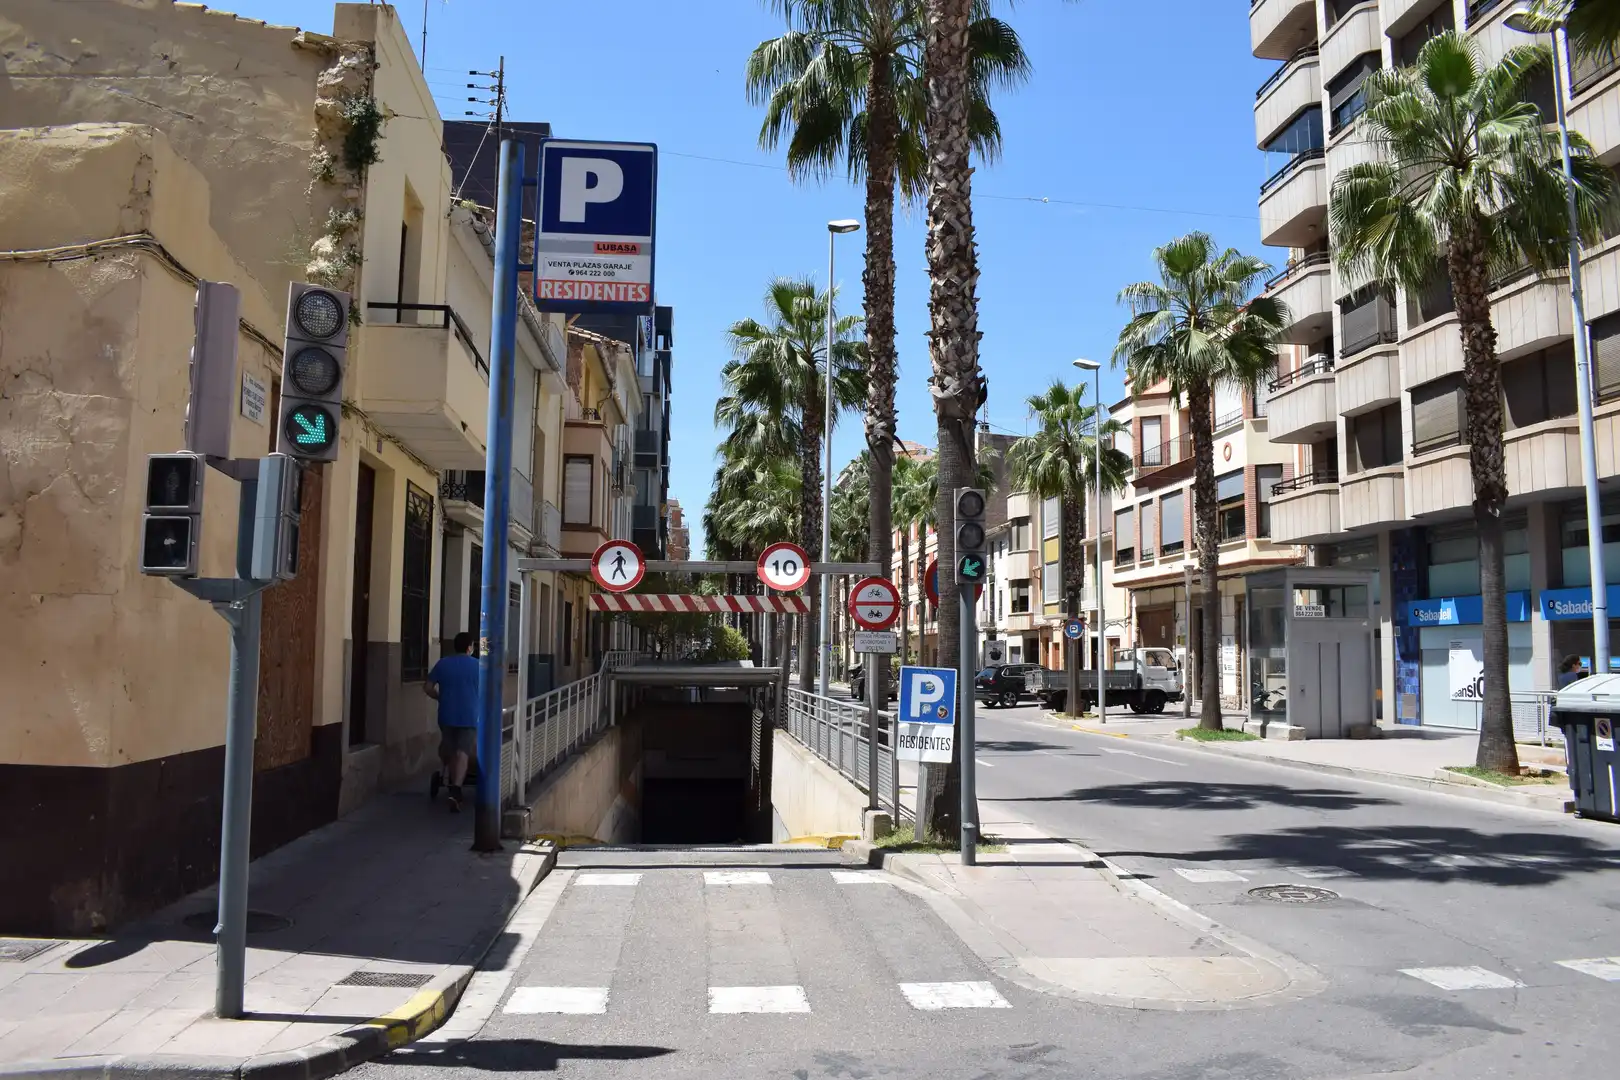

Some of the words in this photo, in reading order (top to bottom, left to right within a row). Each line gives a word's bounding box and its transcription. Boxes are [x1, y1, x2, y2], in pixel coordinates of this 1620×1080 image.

[559, 156, 624, 223] P
[596, 243, 637, 252] LUBASA
[540, 280, 648, 302] RESIDENTES
[772, 560, 797, 576] 10
[1419, 608, 1452, 621] Sabadell
[1555, 600, 1593, 615] Sabade
[910, 673, 945, 718] P
[899, 734, 951, 751] RESIDENTES
